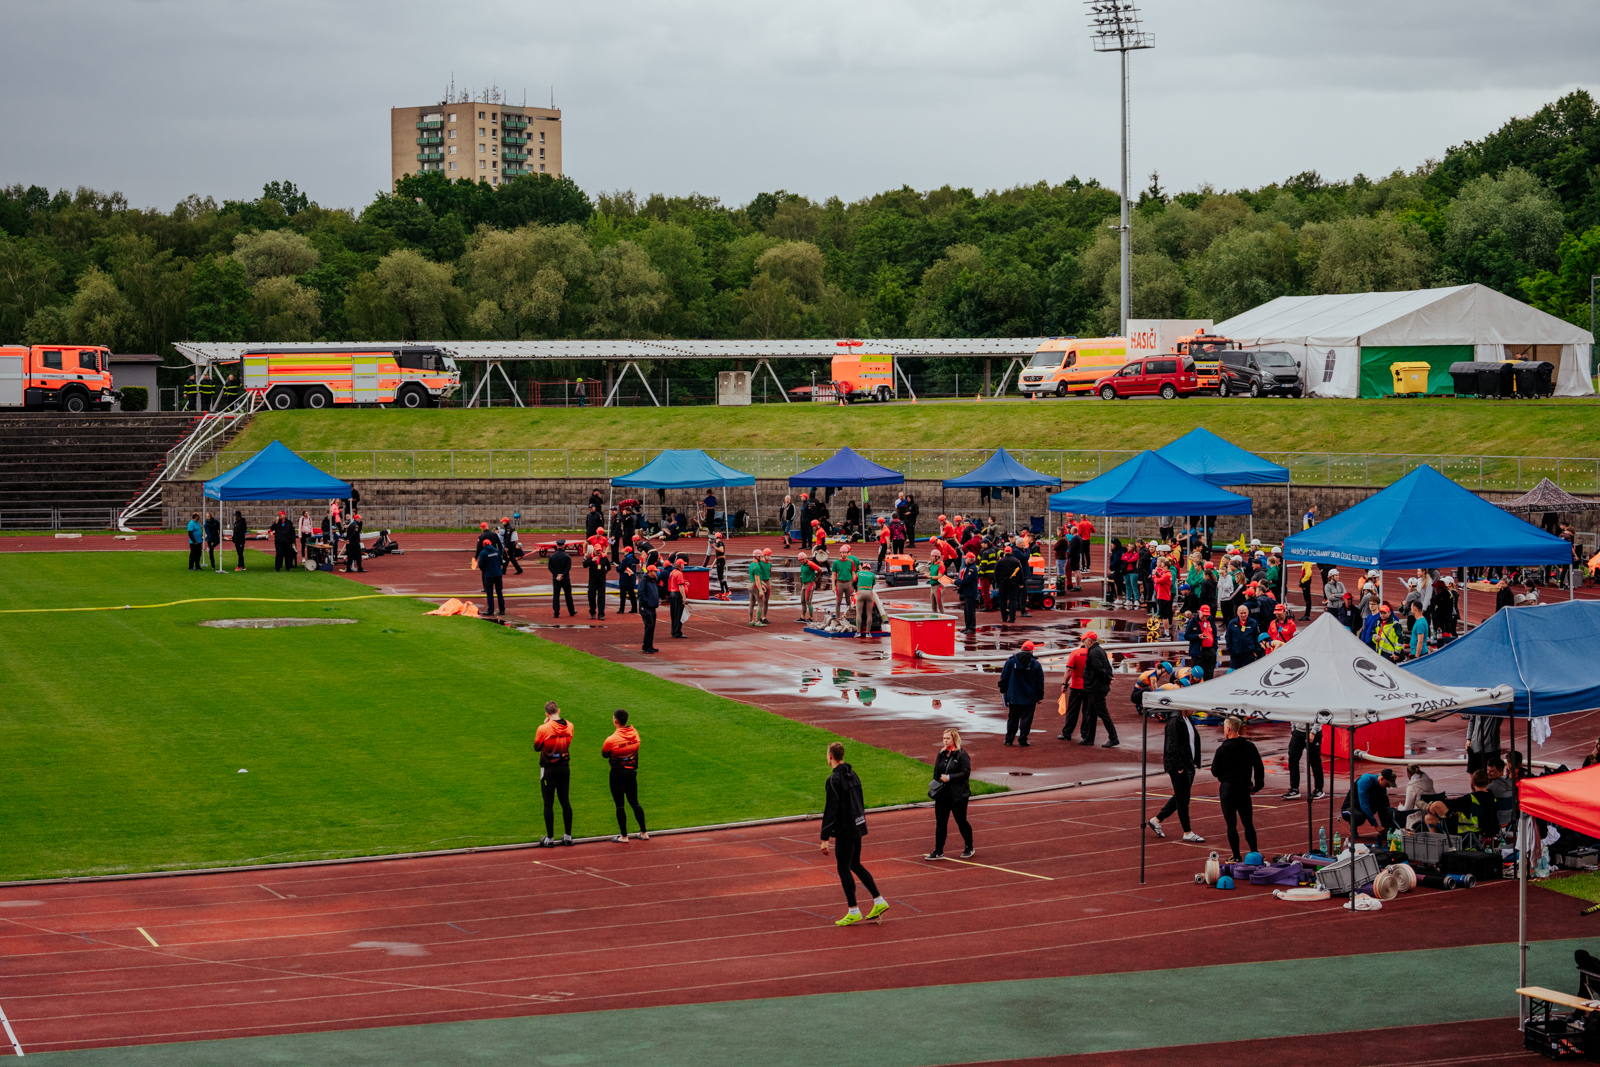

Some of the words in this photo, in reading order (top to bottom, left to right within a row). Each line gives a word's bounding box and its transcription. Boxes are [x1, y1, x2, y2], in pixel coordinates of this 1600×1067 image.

[1130, 328, 1156, 349] HASIČI
[1229, 689, 1295, 698] 24MX
[1411, 697, 1458, 714] 24MX
